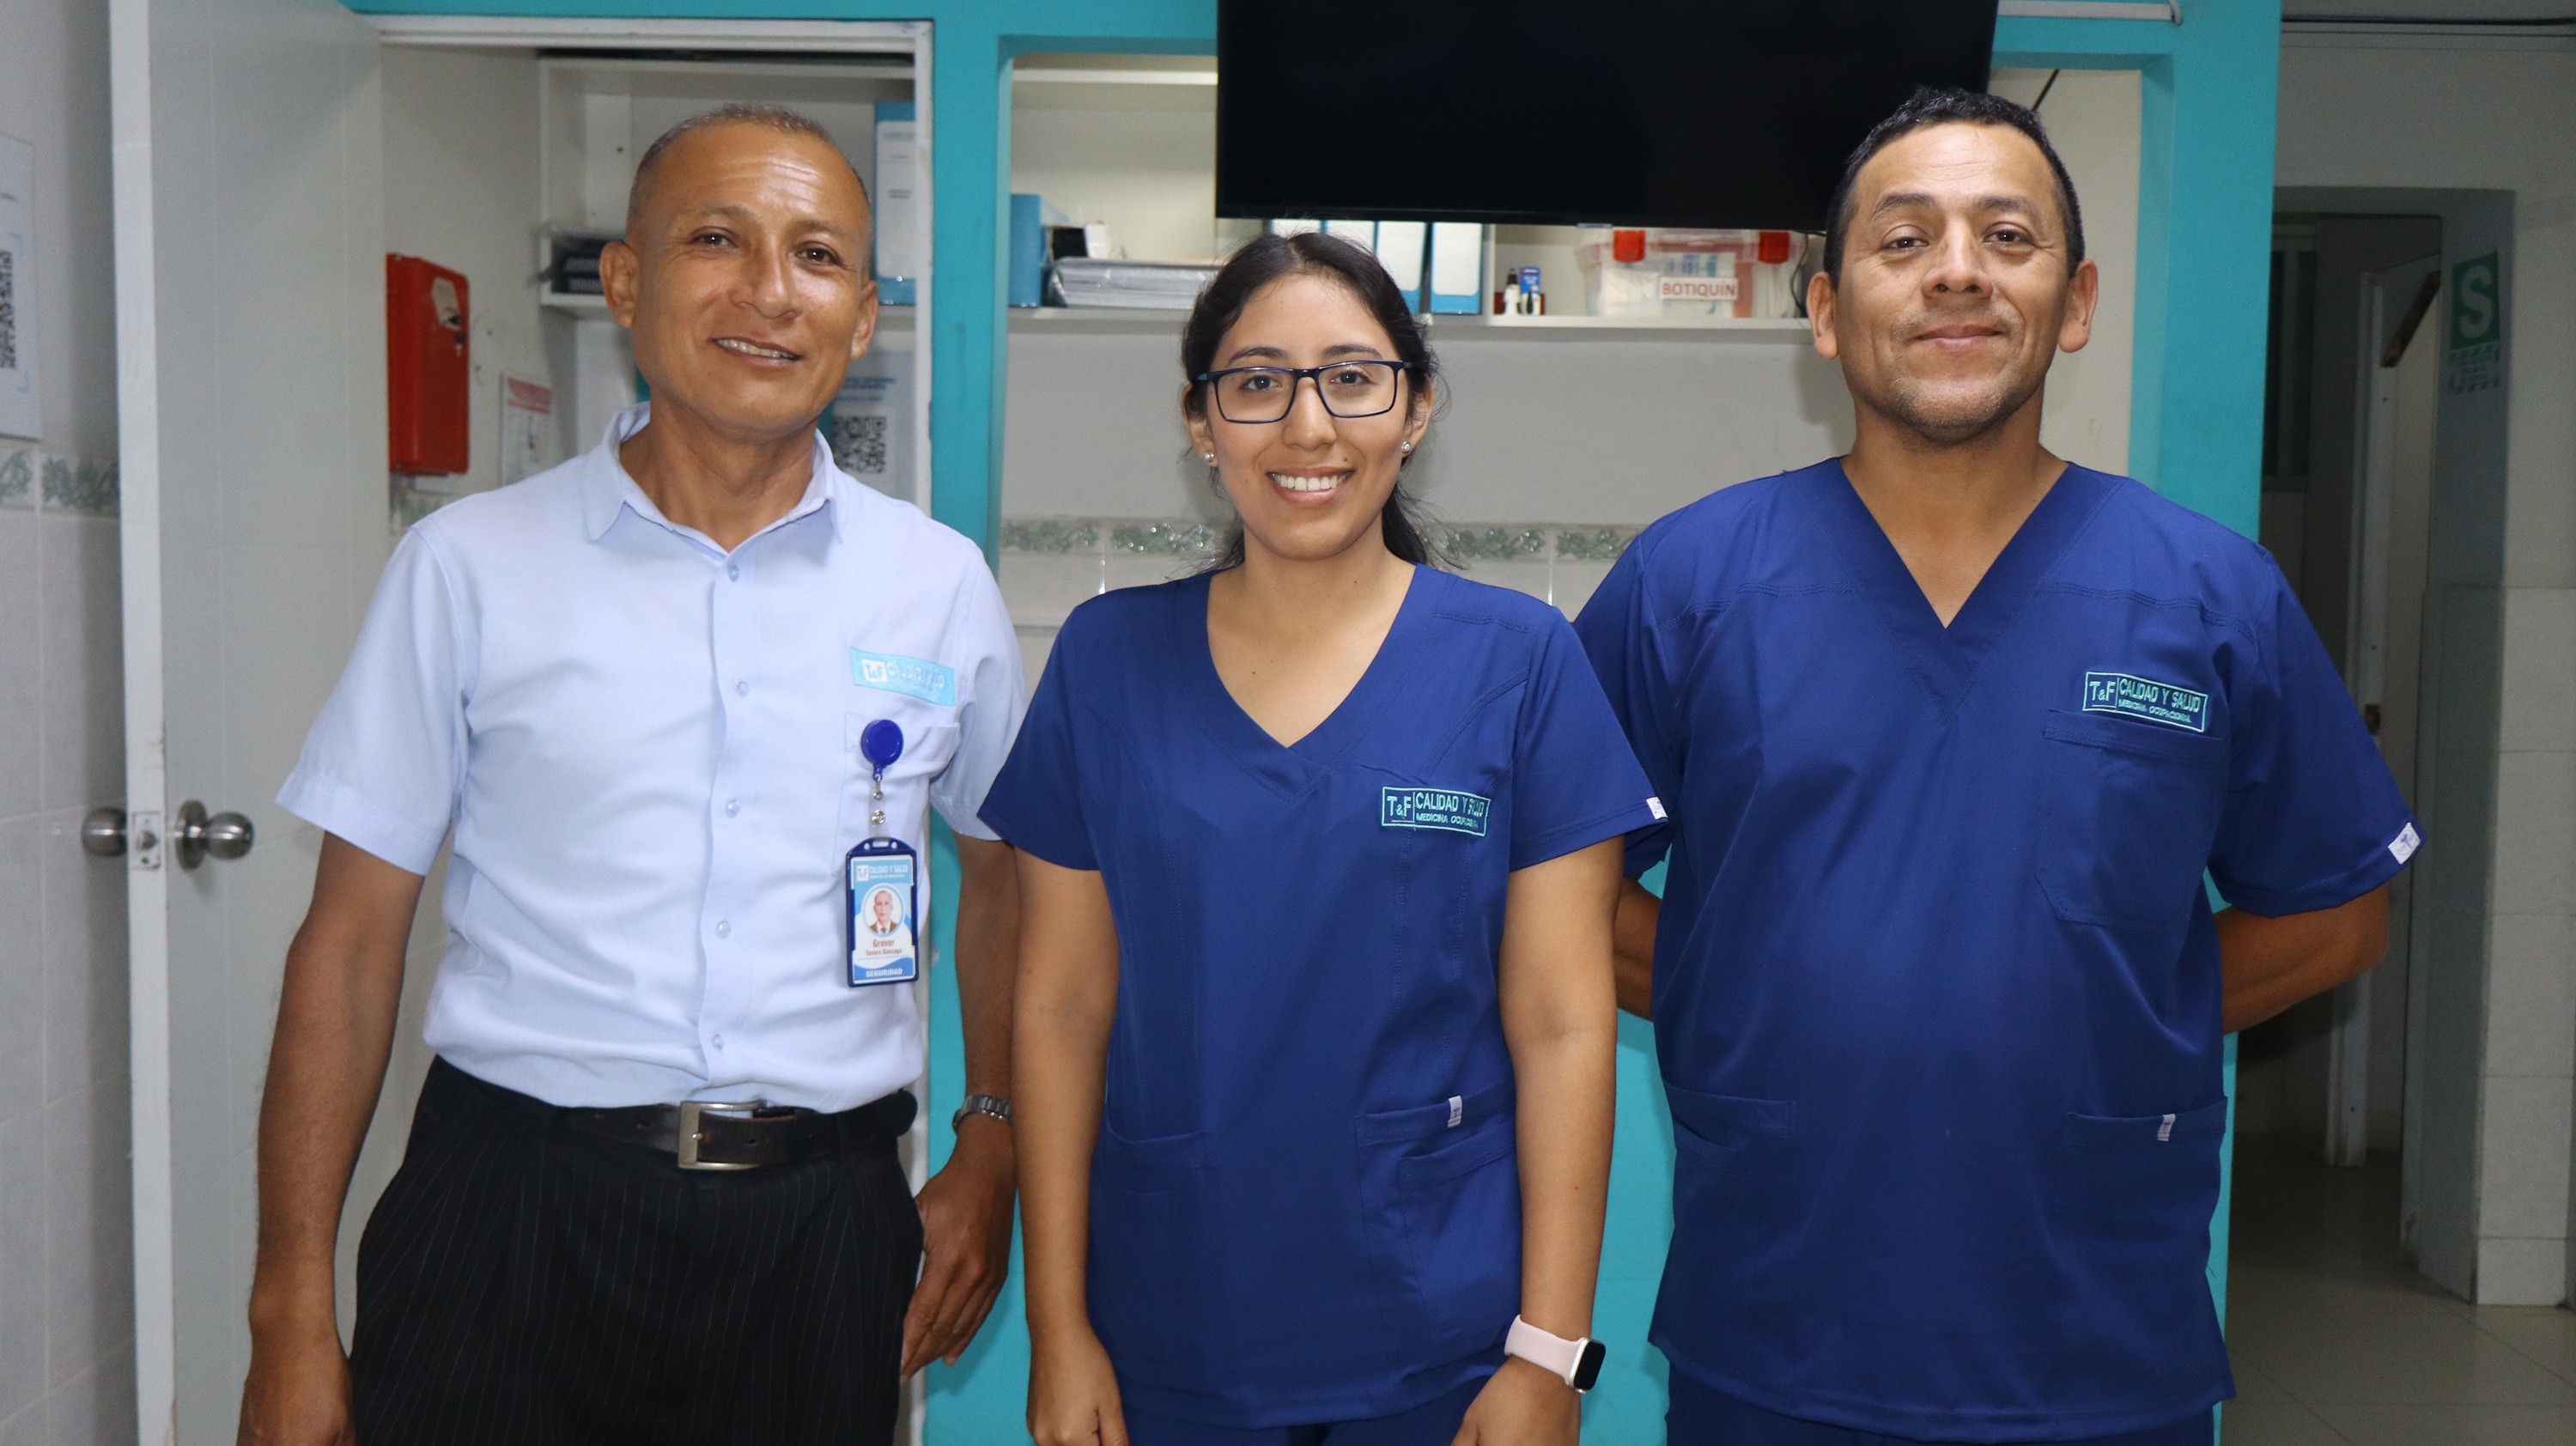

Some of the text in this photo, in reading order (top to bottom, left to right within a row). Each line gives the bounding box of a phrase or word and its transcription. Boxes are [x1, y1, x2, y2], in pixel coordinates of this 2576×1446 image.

[1662, 281, 1735, 297] BOTIQUÍN
[2089, 680, 2117, 702] T&F
[2119, 678, 2202, 713] CALIDAD Y SALUD
[1387, 795, 1412, 817] T&F
[1415, 792, 1459, 812] CALIDAD
[1462, 796, 1467, 813] Y
[1416, 812, 1449, 823] MEDICINA
[873, 939, 895, 947] Grover
[866, 968, 902, 977] SEGURIDAD
